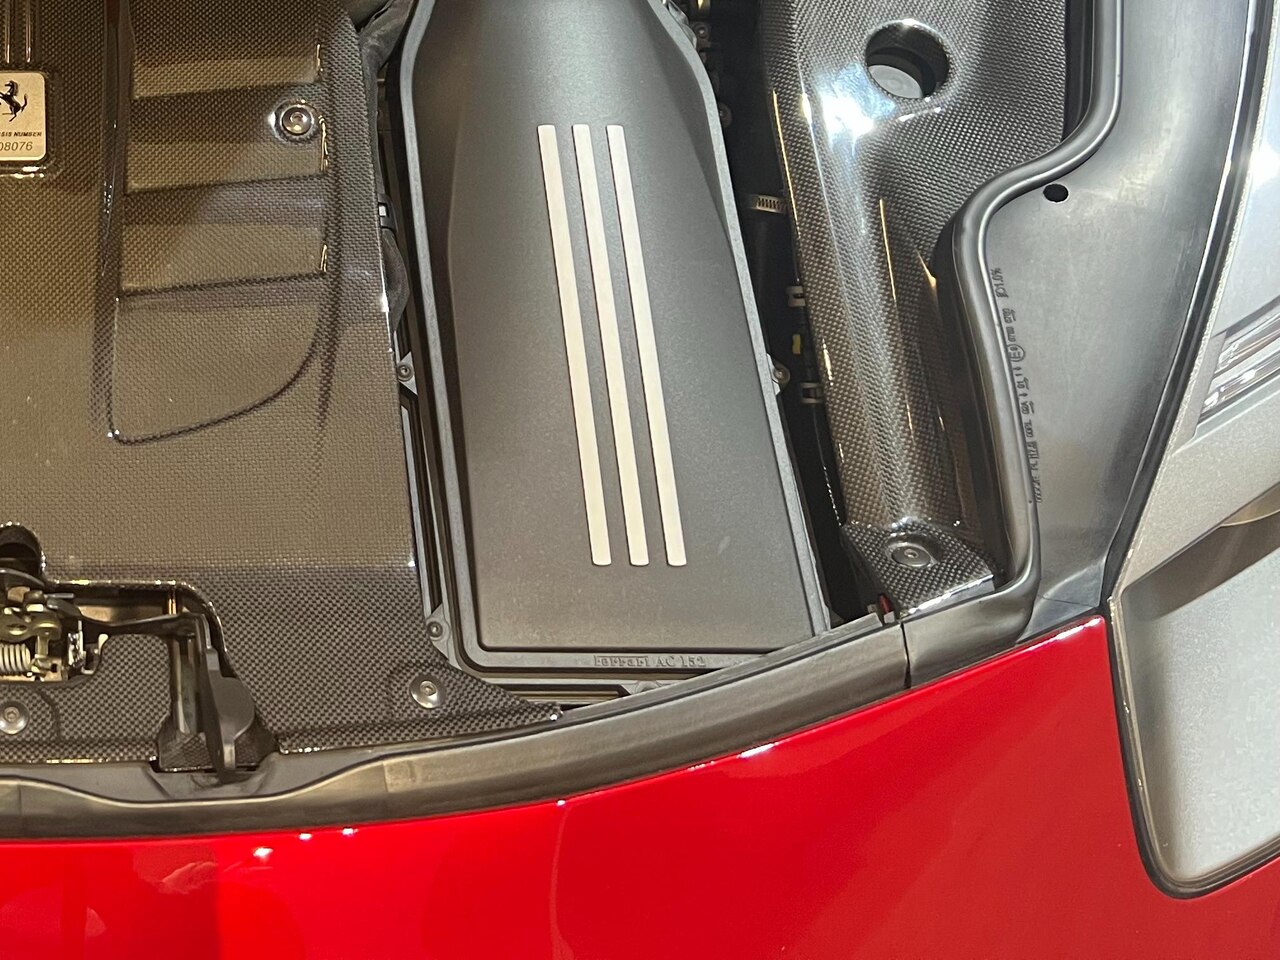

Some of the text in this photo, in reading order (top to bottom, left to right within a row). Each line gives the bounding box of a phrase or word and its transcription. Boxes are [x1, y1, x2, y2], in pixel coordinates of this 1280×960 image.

[594, 655, 707, 667] Ferrari AC 152
